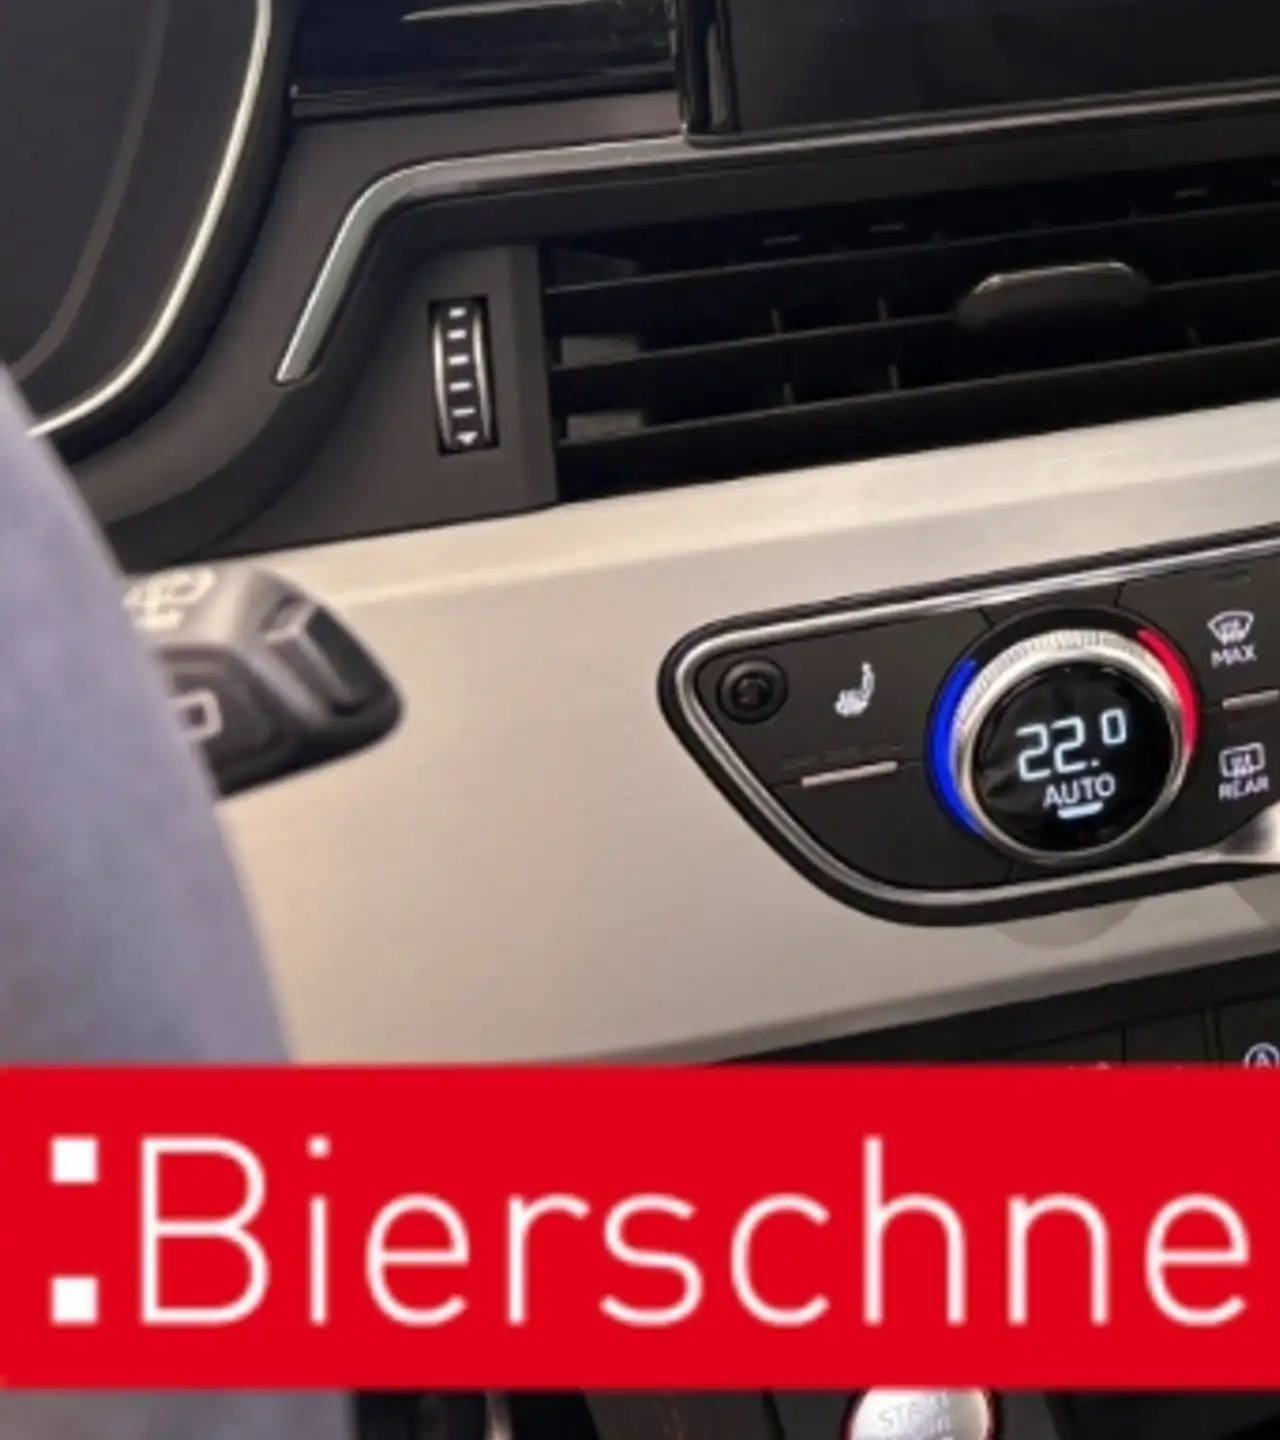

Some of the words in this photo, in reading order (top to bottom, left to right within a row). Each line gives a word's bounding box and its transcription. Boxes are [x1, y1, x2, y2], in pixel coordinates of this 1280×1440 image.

[1210, 643, 1258, 669] MAX
[1041, 772, 1116, 810] AUTO
[1217, 775, 1271, 802] REAR
